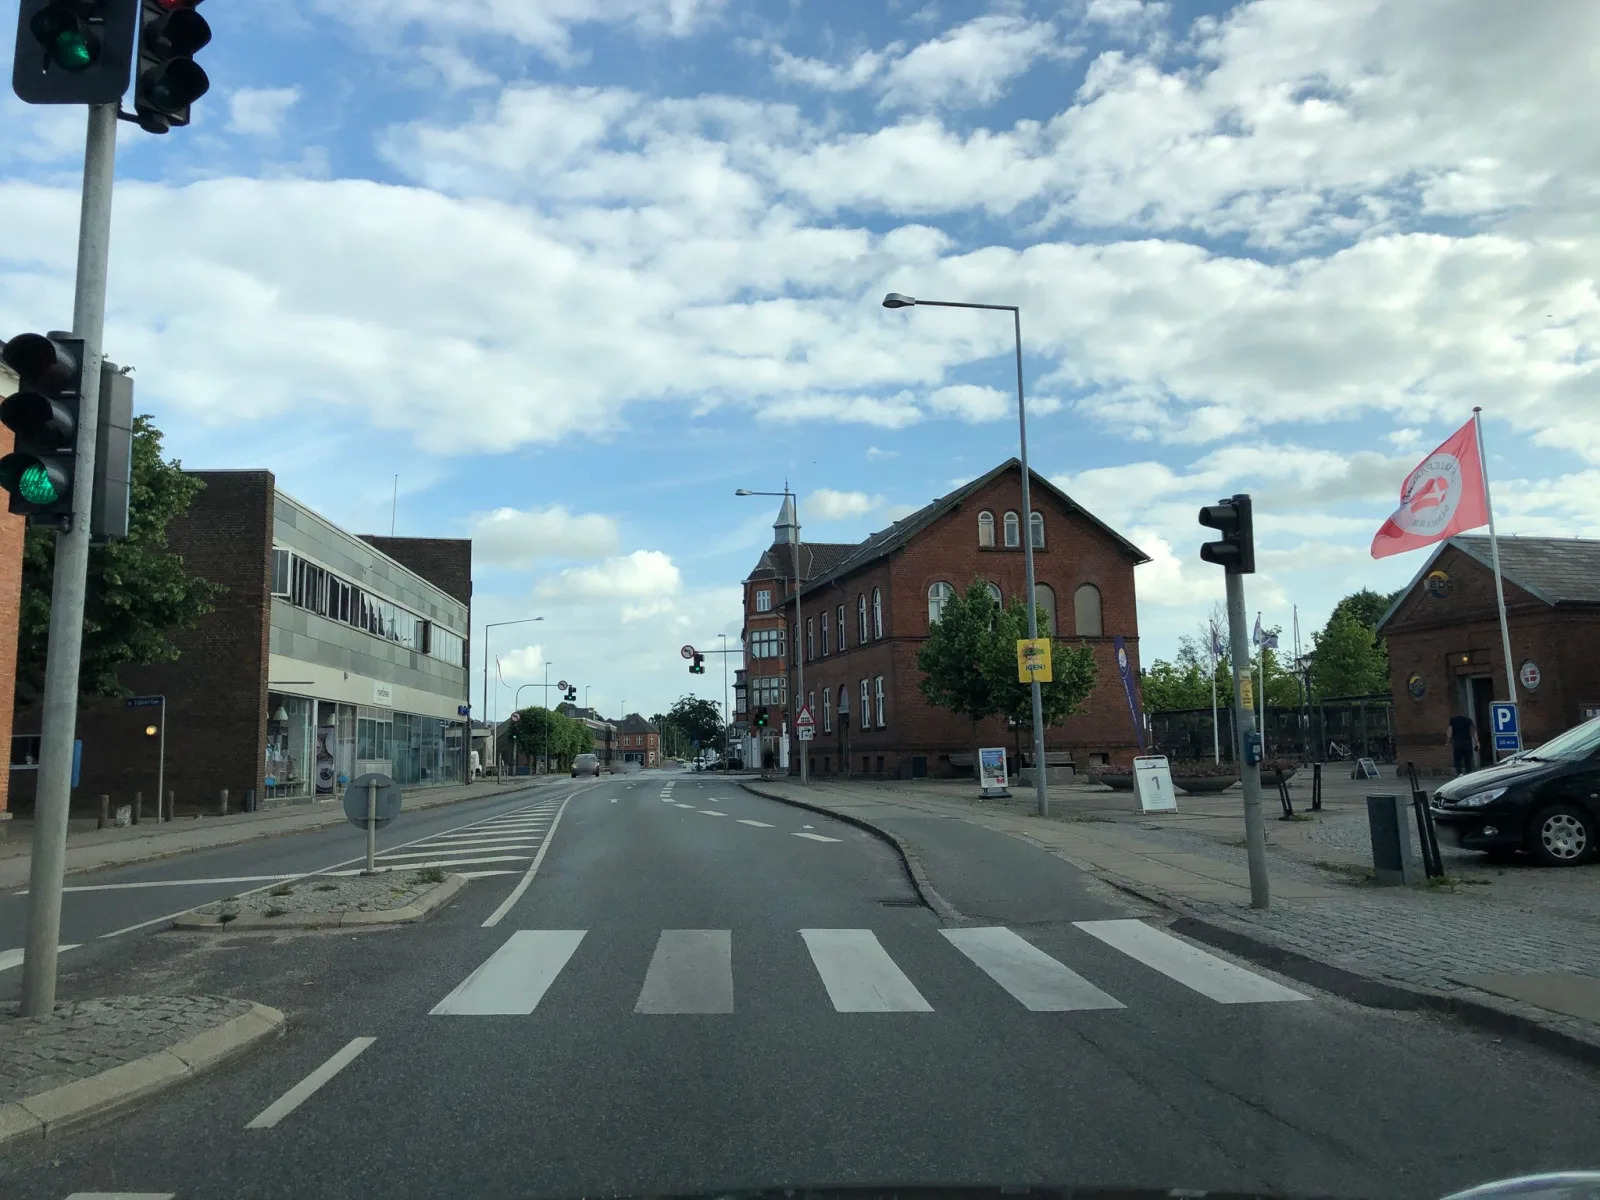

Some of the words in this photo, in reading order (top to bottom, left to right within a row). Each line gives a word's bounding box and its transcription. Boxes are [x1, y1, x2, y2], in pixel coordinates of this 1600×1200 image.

[1430, 580, 1454, 589] EDC
[1497, 708, 1511, 731] P
[1151, 776, 1160, 791] 1
